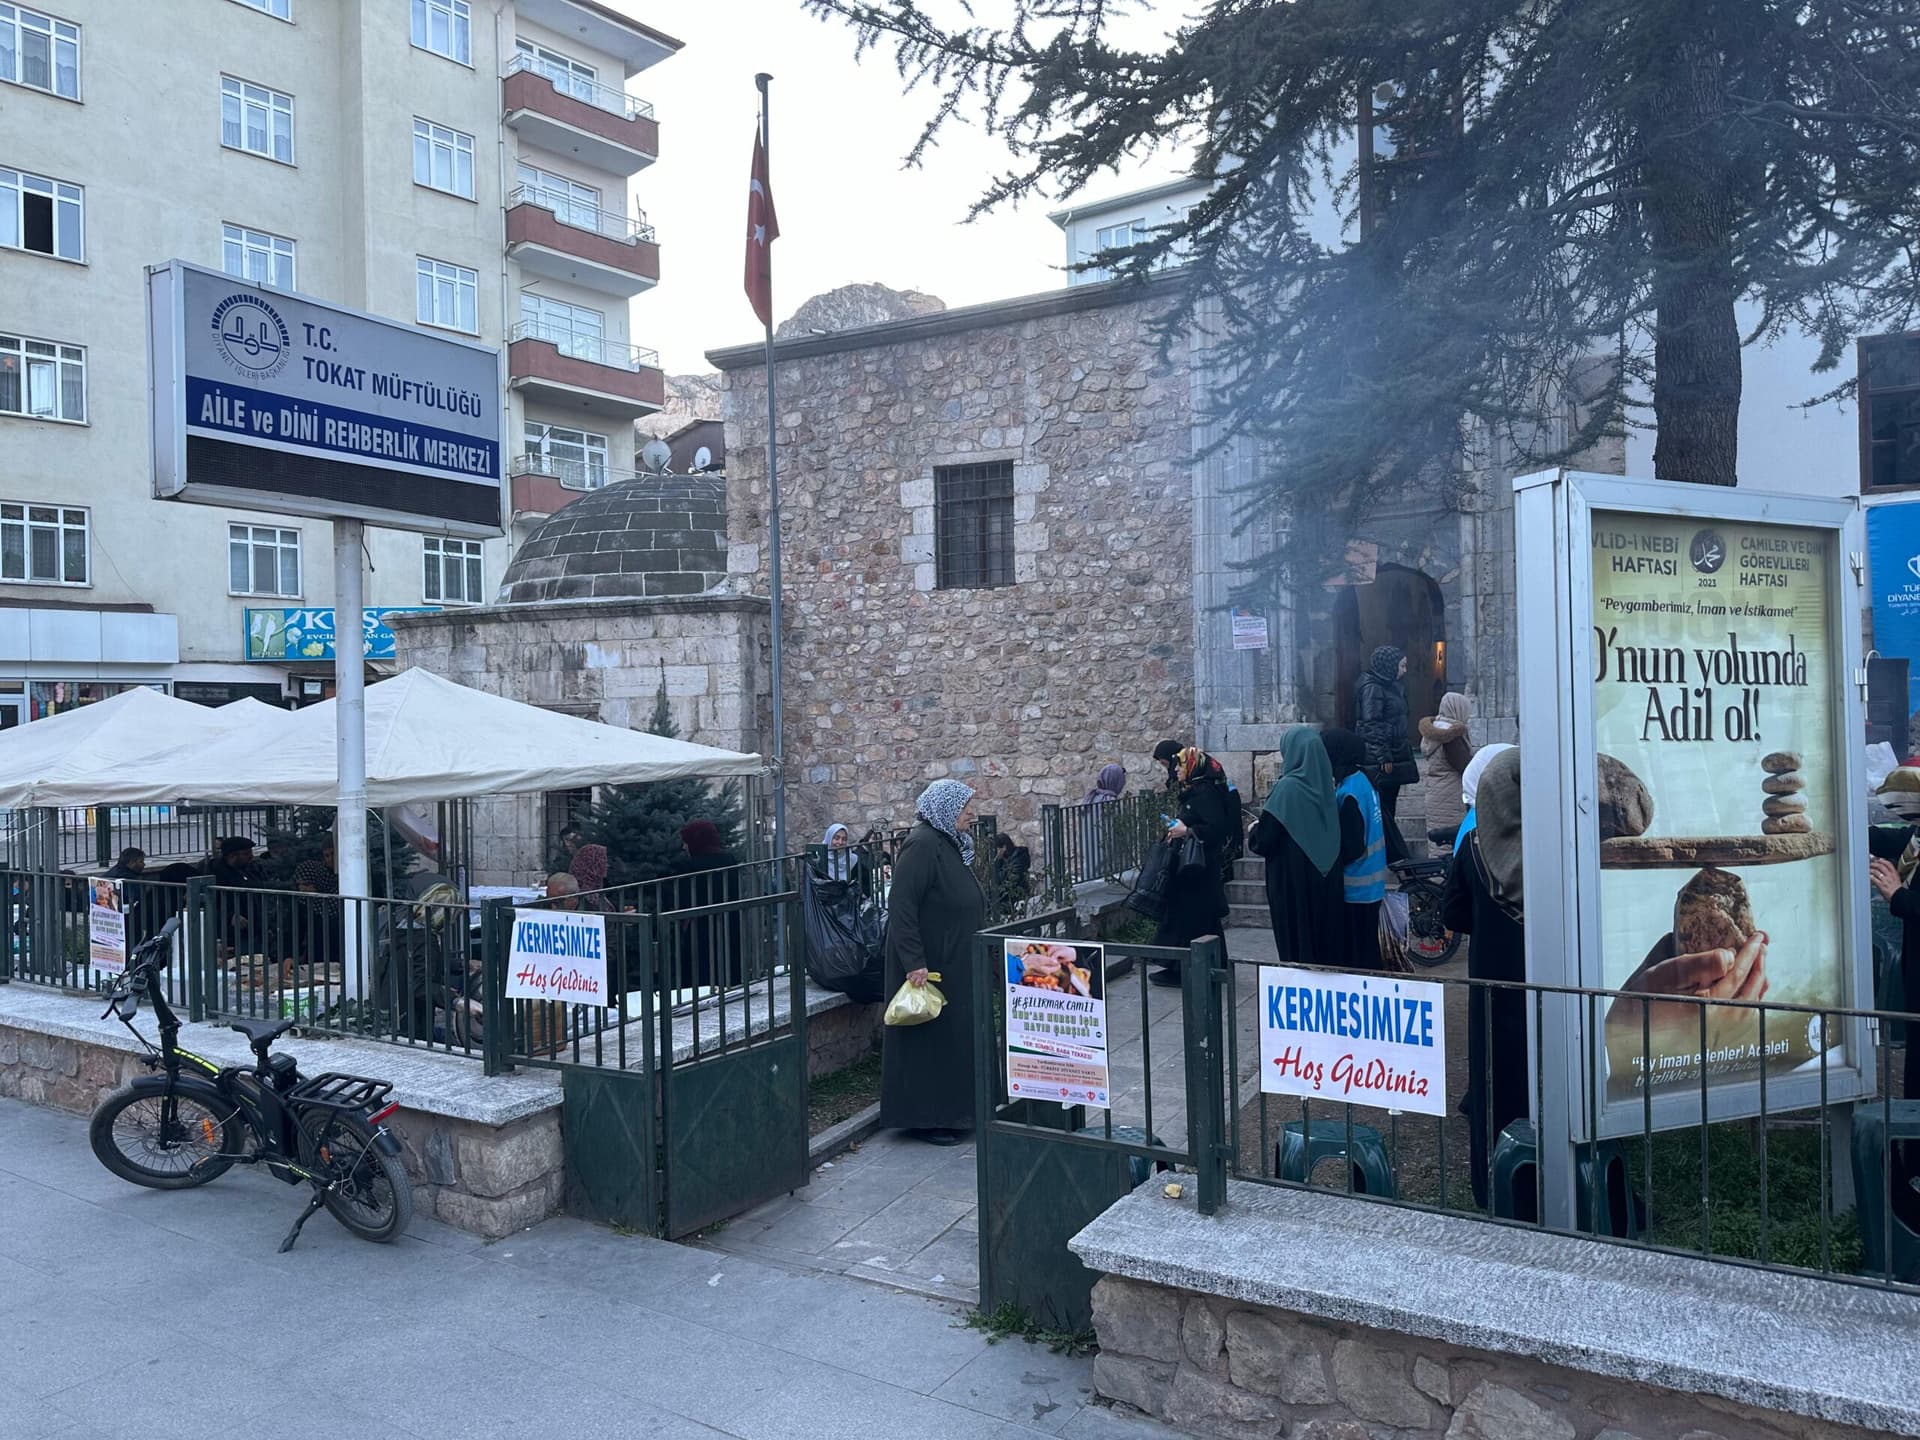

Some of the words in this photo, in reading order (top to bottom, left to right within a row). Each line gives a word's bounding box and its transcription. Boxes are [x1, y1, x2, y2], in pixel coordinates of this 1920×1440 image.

[302, 322, 338, 352] T.C.
[302, 356, 366, 391] TOKAT
[372, 373, 481, 418] MÜFTÜLÜĞÜ
[201, 389, 246, 428] AİLE
[252, 409, 273, 434] ve
[280, 405, 318, 443] DİNİ
[325, 418, 420, 462] REHBERLİK
[424, 438, 491, 475] MERKEZİ
[1642, 535, 1679, 554] NEBİ
[1740, 537, 1789, 553] CAMİLER
[1789, 540, 1805, 554] VE
[1612, 555, 1677, 576] HAFTASI
[1740, 552, 1810, 572] GÖREVLİLERİ
[1698, 578, 1717, 588] 2023
[1740, 573, 1788, 588] HAFTASI
[1697, 600, 1726, 616] İman
[1729, 605, 1742, 616] ve
[1694, 631, 1808, 698] yolunda
[1639, 686, 1714, 742] Adil
[1724, 687, 1761, 742] ol!
[516, 915, 601, 960] KERMESİMİZE
[516, 963, 547, 994] Hoş
[550, 966, 599, 995] Geldiniz
[1267, 980, 1434, 1048] KERMESİMİZE
[1273, 1045, 1324, 1091] Hoş
[1330, 1053, 1429, 1097] Geldiniz
[1659, 1054, 1691, 1069] iman
